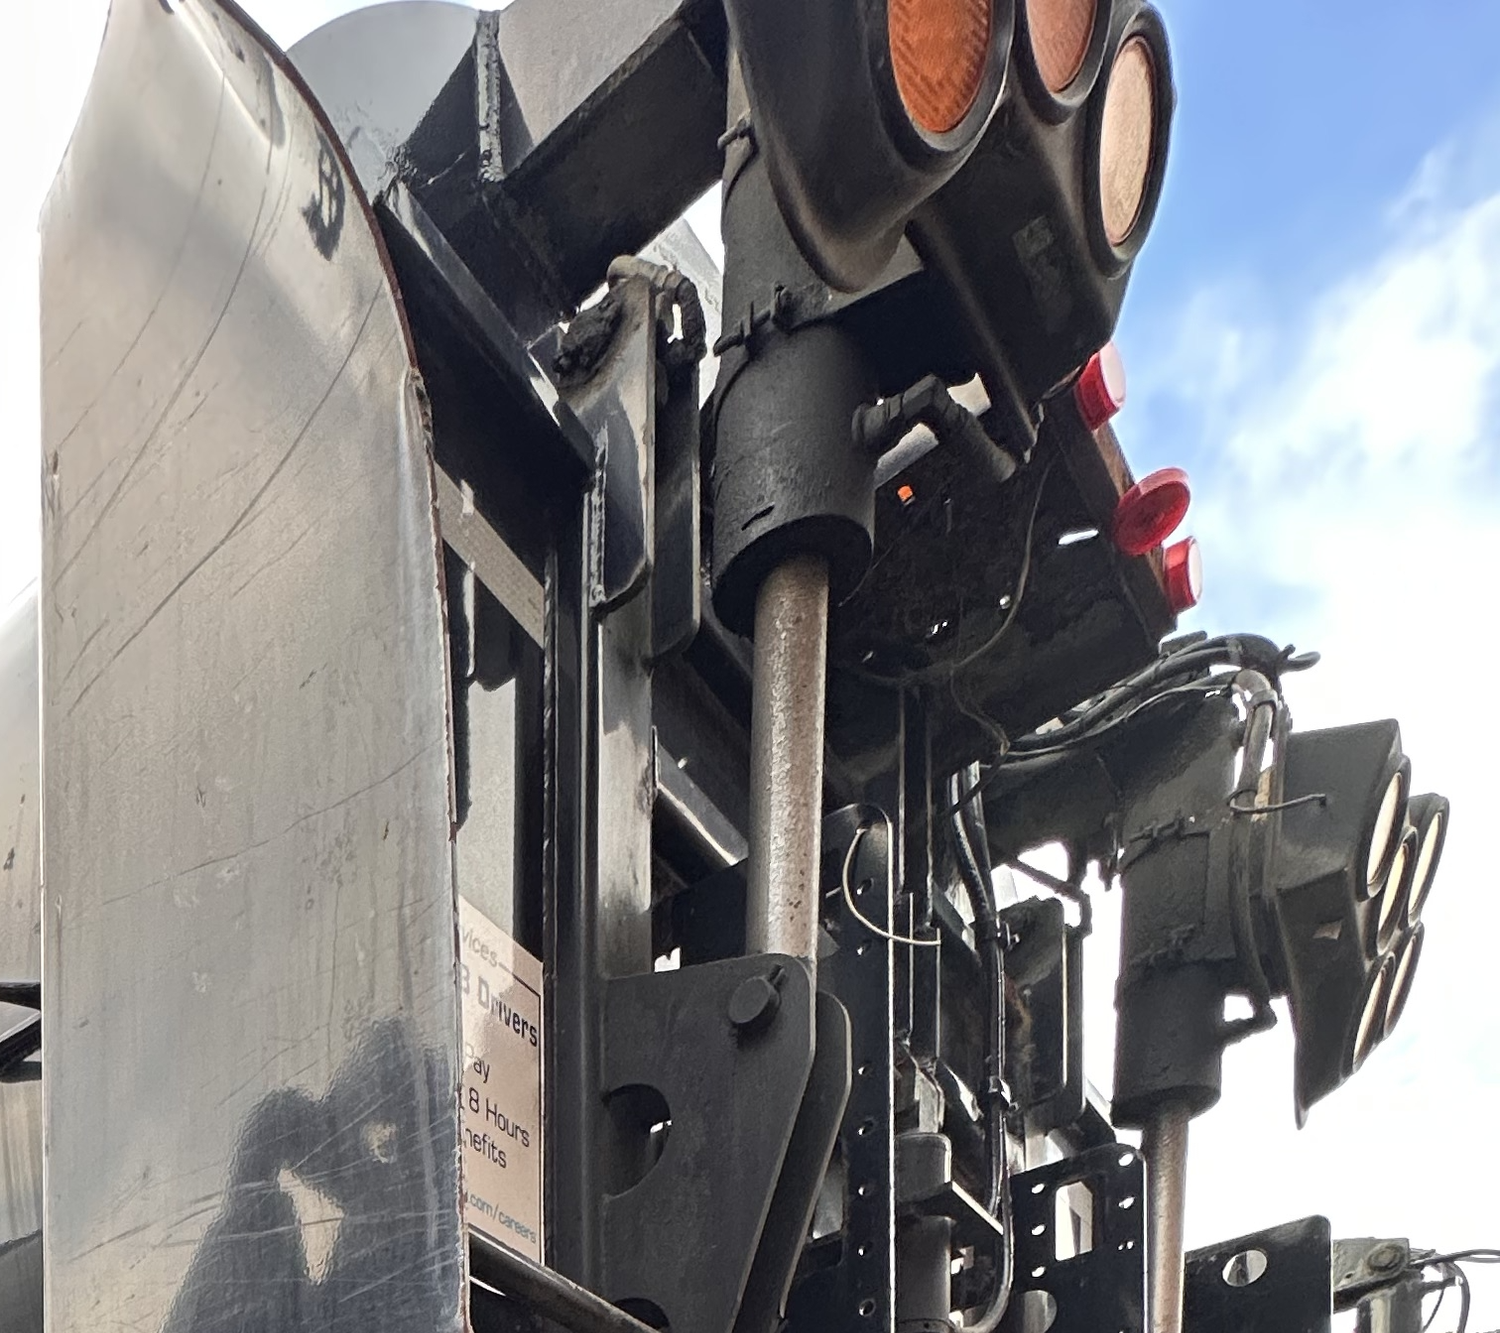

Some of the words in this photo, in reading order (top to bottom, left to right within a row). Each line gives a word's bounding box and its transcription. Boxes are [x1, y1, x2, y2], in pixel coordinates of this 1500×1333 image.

[479, 976, 537, 1047] Drivers
[469, 1087, 479, 1114] 8
[486, 1097, 530, 1148] Hours
